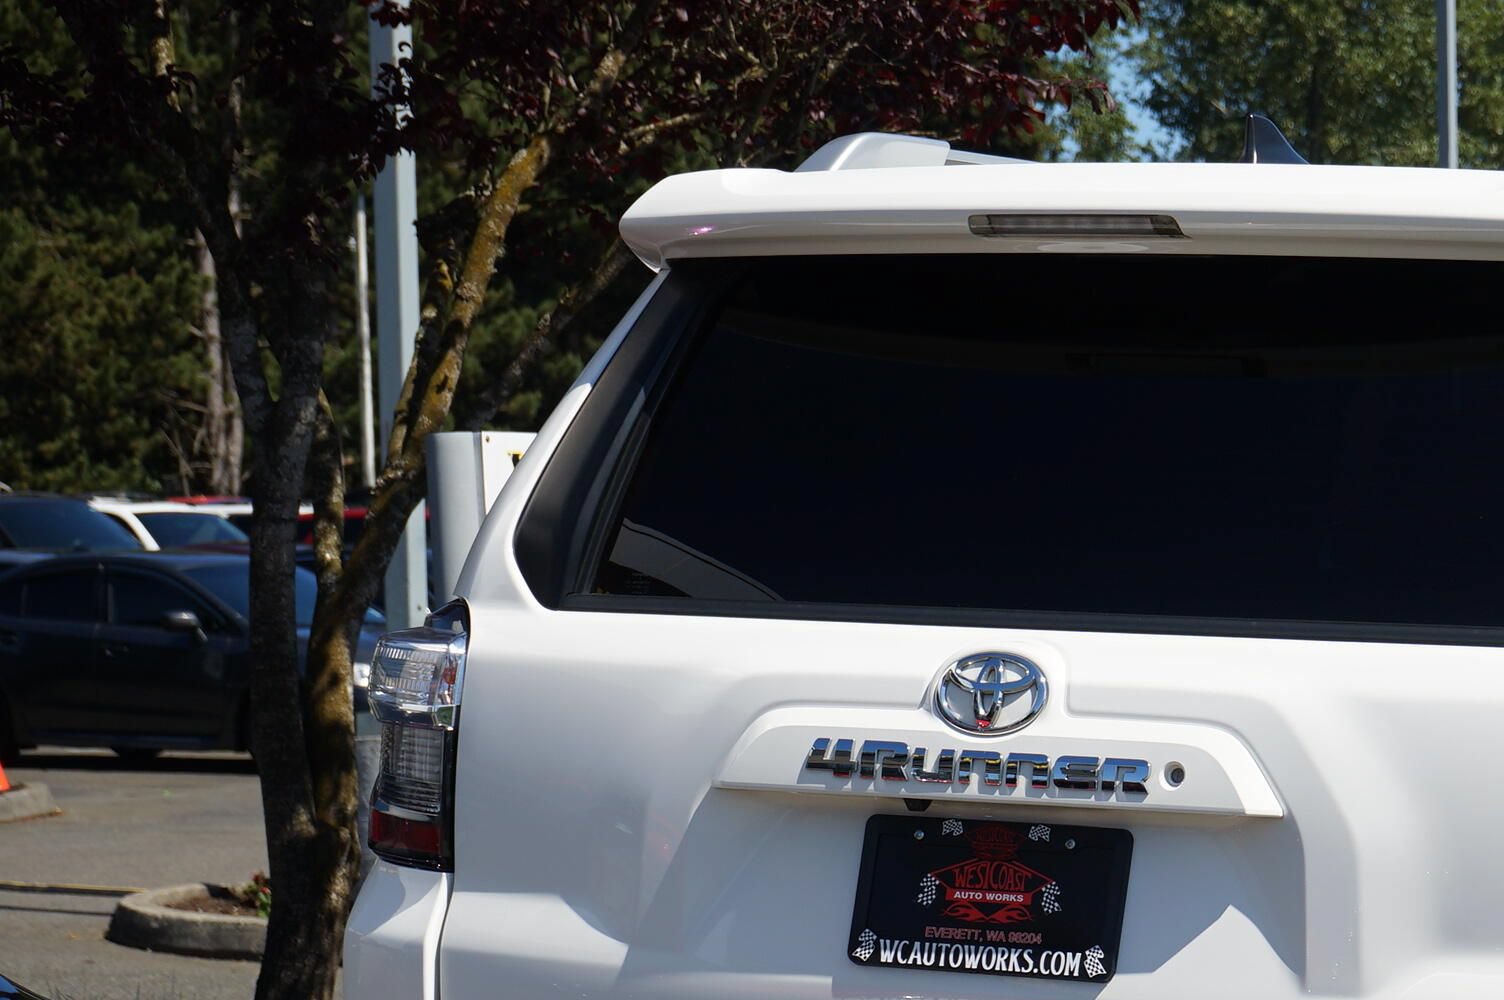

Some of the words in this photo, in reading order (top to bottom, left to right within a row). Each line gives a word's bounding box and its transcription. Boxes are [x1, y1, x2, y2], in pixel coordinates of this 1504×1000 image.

[953, 891, 983, 900] AUTO
[985, 892, 1024, 902] WORKS
[925, 926, 983, 942] EVERETT,
[986, 930, 1006, 943] WA
[879, 939, 1082, 977] WCAUTOWORKS.COM
